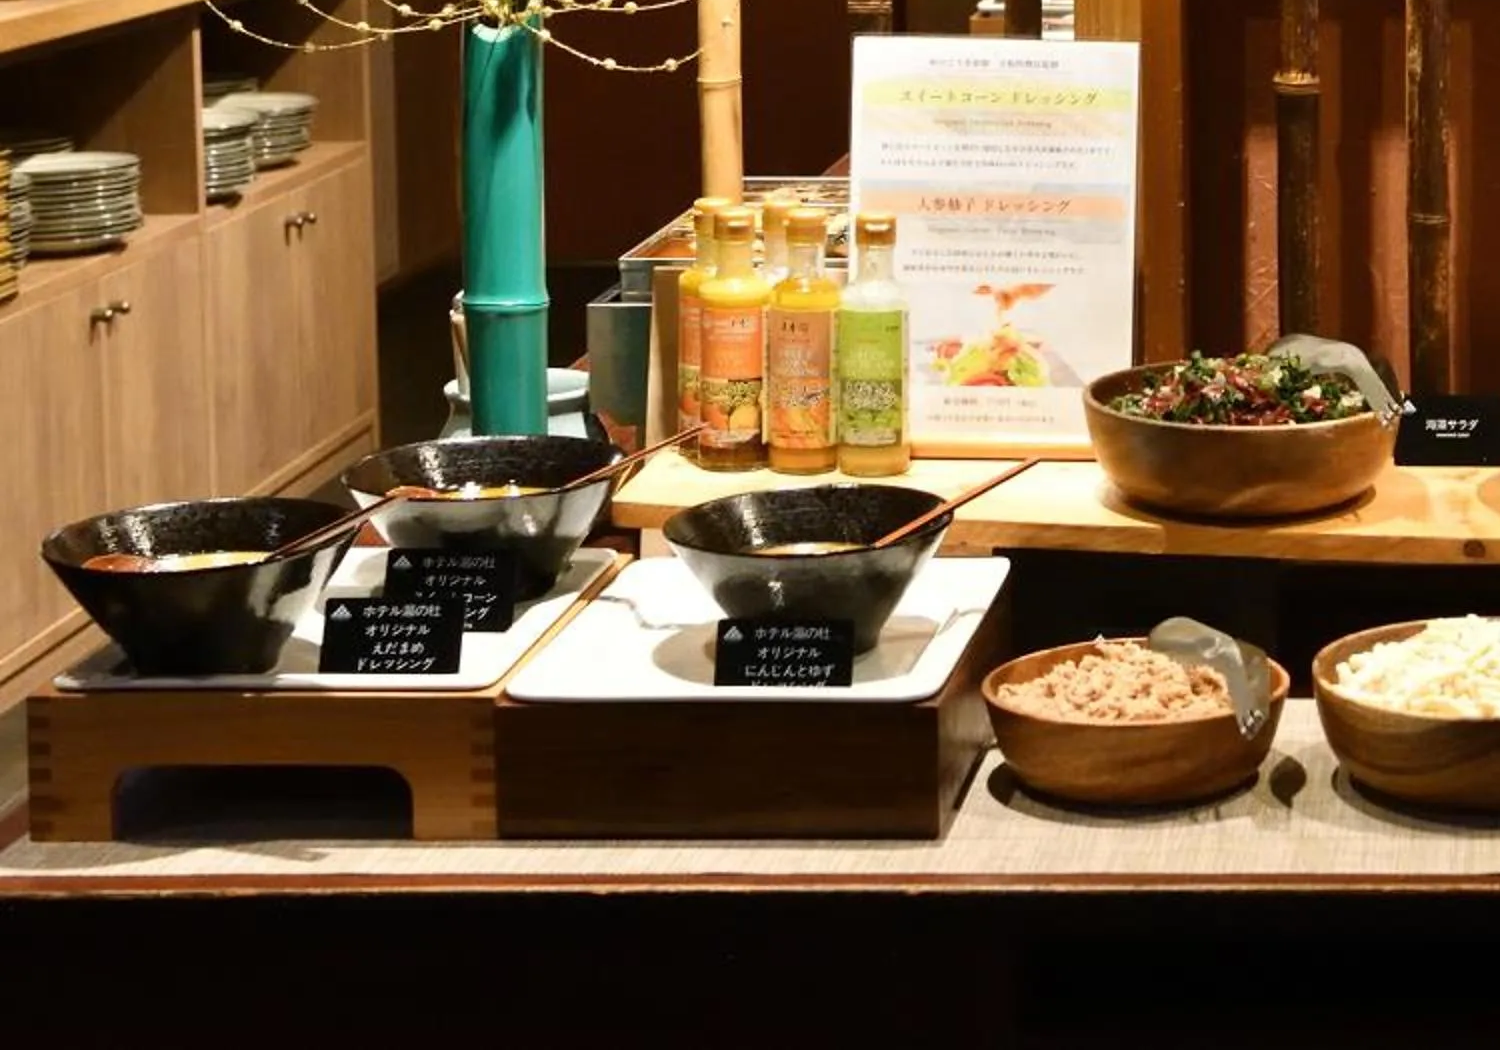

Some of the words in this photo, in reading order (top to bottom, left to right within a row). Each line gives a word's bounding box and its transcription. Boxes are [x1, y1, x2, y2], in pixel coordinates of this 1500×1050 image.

[425, 575, 487, 587] オリジナル
[364, 624, 431, 637] オリジナル
[371, 641, 425, 655] えだまめ
[757, 646, 822, 660] オリジナル
[357, 656, 437, 672] ドレッシング
[744, 663, 836, 679] にんじんとゆず
